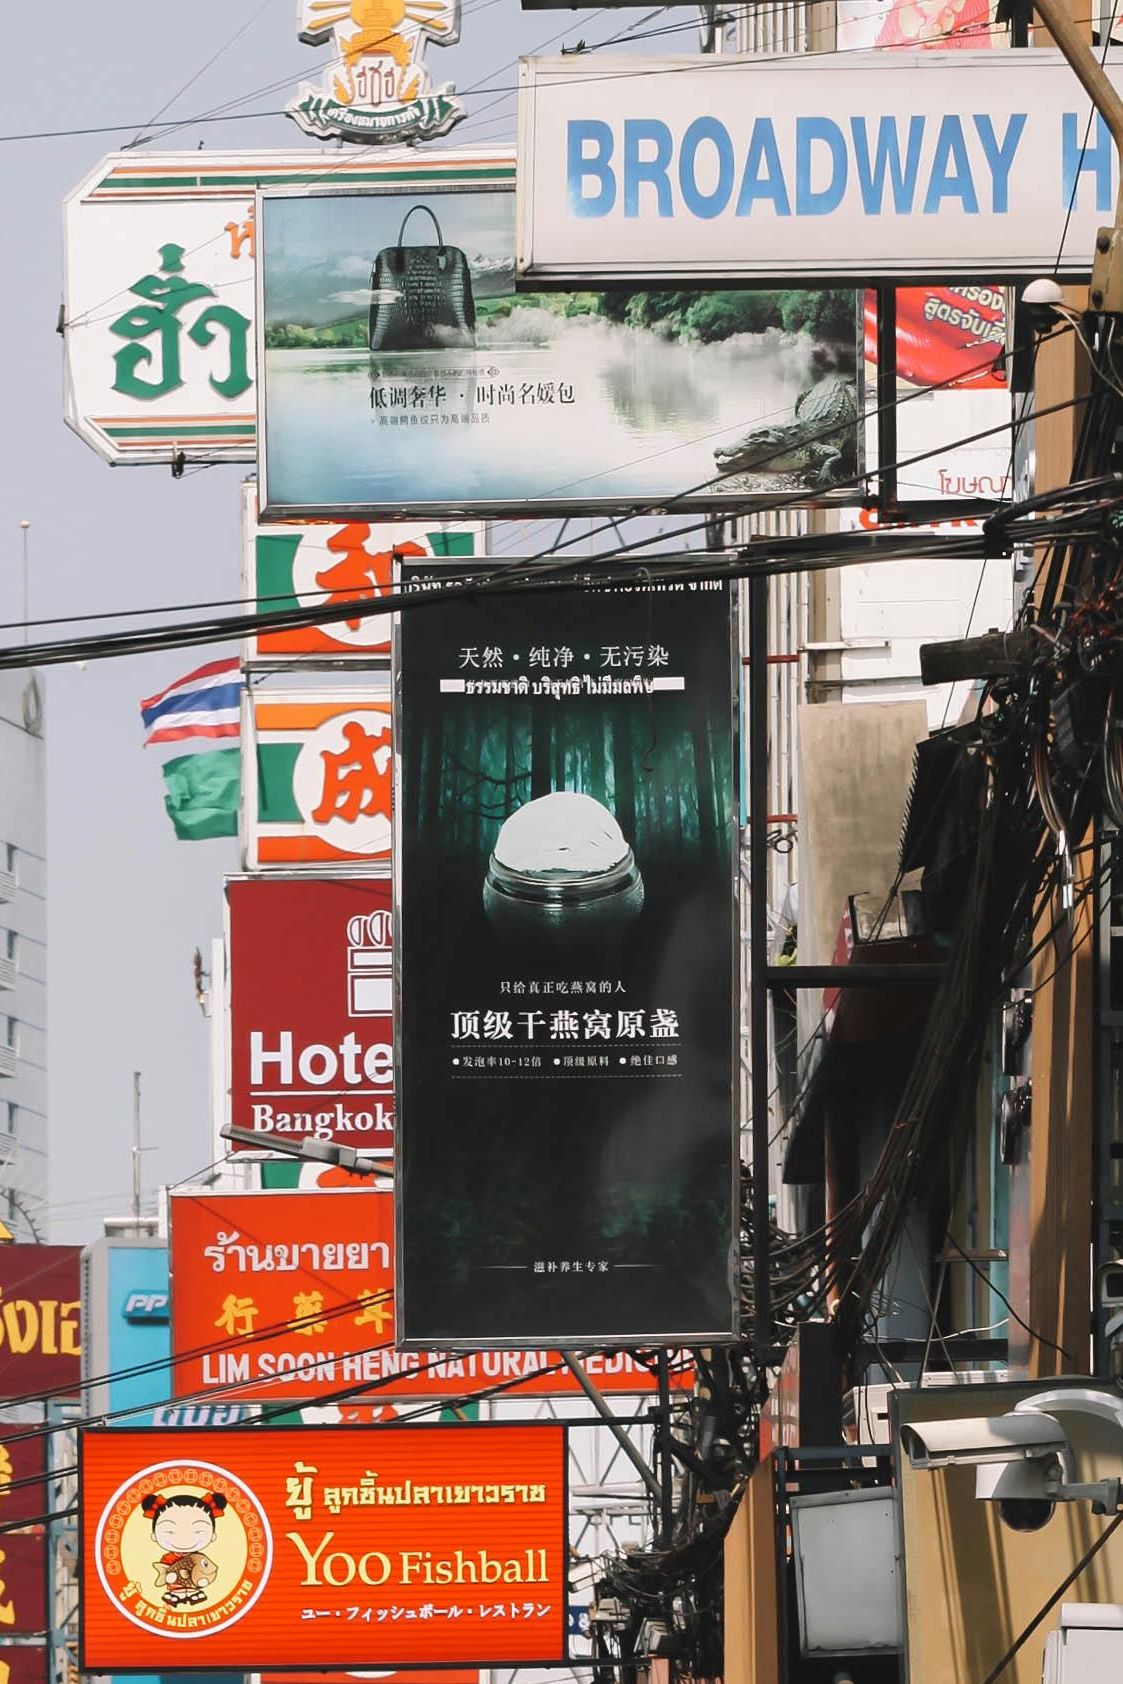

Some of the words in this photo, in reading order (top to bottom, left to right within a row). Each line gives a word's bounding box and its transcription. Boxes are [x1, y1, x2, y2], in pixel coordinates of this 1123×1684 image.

[567, 113, 1027, 220] BROADWAY
[450, 1009, 680, 1040] 顶级干燕窝原盏
[251, 1104, 394, 1141] Bangkok
[203, 1231, 390, 1273] ร้านขายยา
[202, 1353, 250, 1384] LIM
[258, 1352, 335, 1382] SOON
[343, 1351, 419, 1382] HENG
[324, 1471, 546, 1517] ลูกชิ้นปลาเยาวราช
[399, 1548, 550, 1584] Fishball
